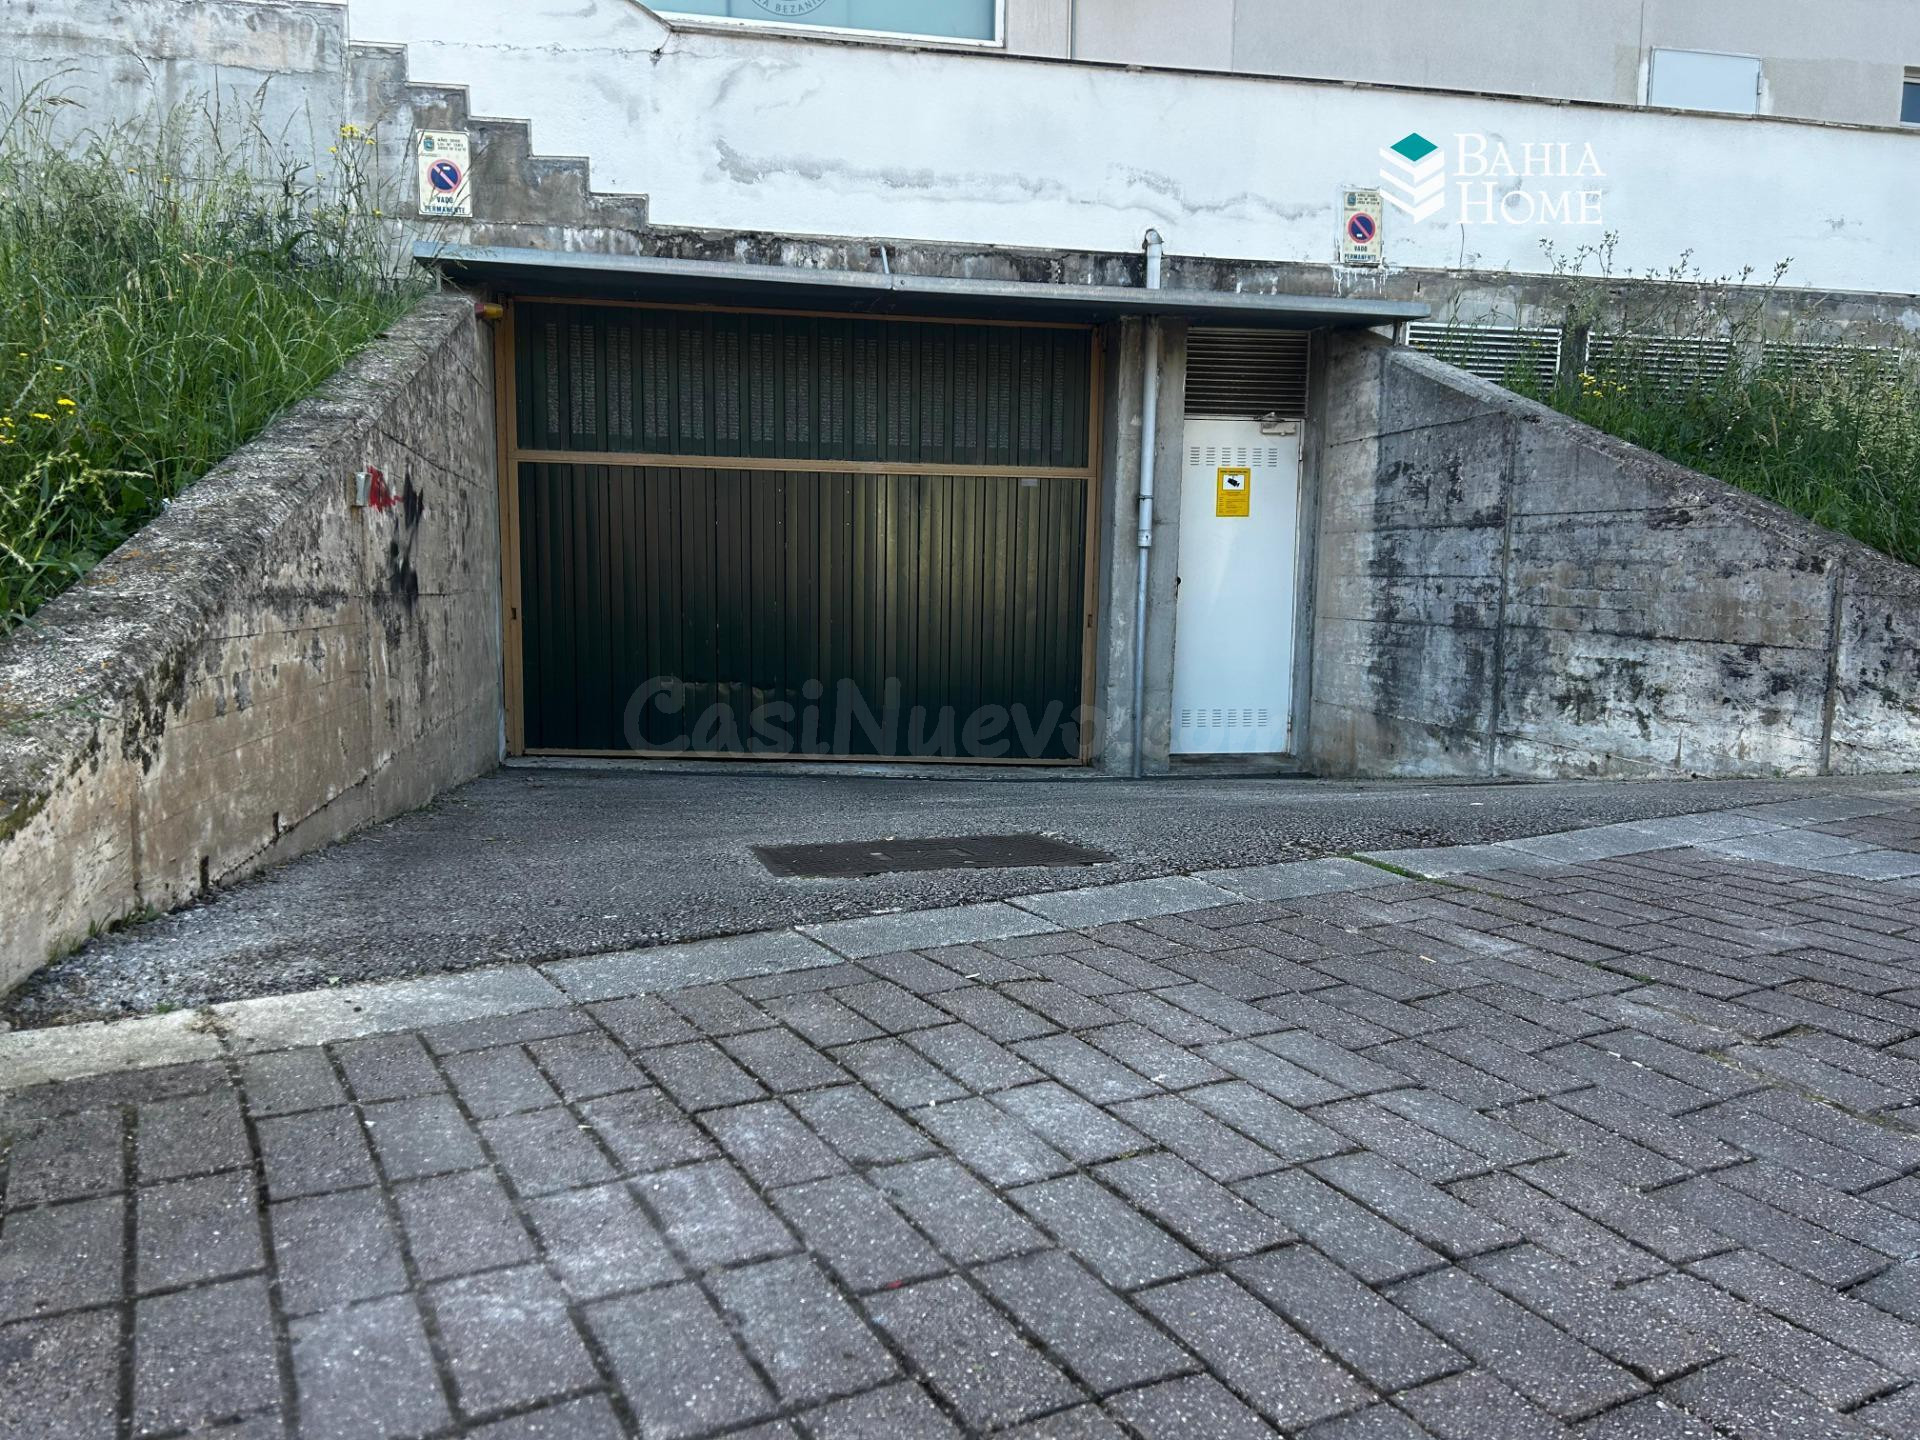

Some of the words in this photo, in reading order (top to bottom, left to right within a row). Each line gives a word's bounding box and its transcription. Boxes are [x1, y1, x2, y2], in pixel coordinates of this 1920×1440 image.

[436, 196, 454, 204] VADO
[424, 205, 465, 214] PERMANENTE
[1354, 245, 1368, 253] VADO
[1344, 253, 1377, 261] PERMANENTE
